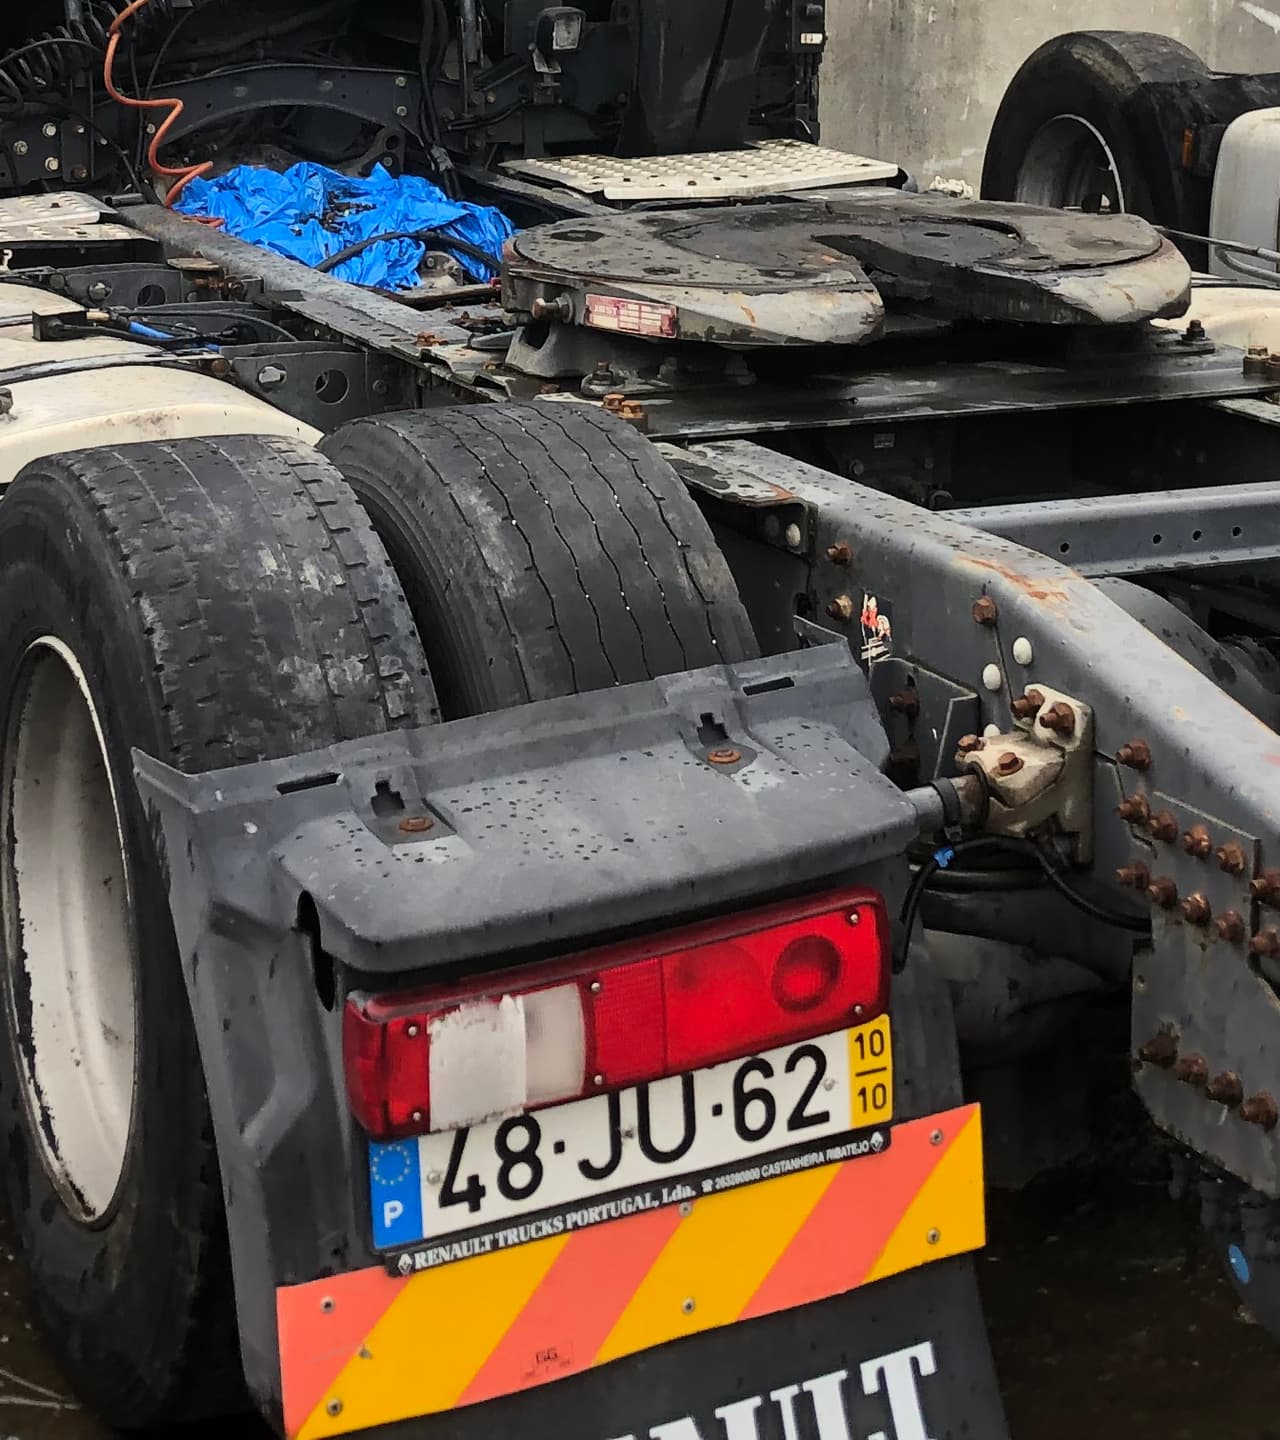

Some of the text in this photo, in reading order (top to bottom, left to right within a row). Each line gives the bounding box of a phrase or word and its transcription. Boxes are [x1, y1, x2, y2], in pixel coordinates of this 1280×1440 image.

[853, 1028, 885, 1060] 10
[855, 1082, 887, 1114] 10
[383, 1200, 404, 1228] P
[413, 1233, 494, 1271] RENAULT
[495, 1214, 565, 1248] TRUCKS
[565, 1194, 660, 1230] PORTUGAL,
[662, 1183, 697, 1205] Lda.
[761, 1151, 825, 1179] CASTANHEIRA
[825, 1138, 870, 1163] RIBATEJO
